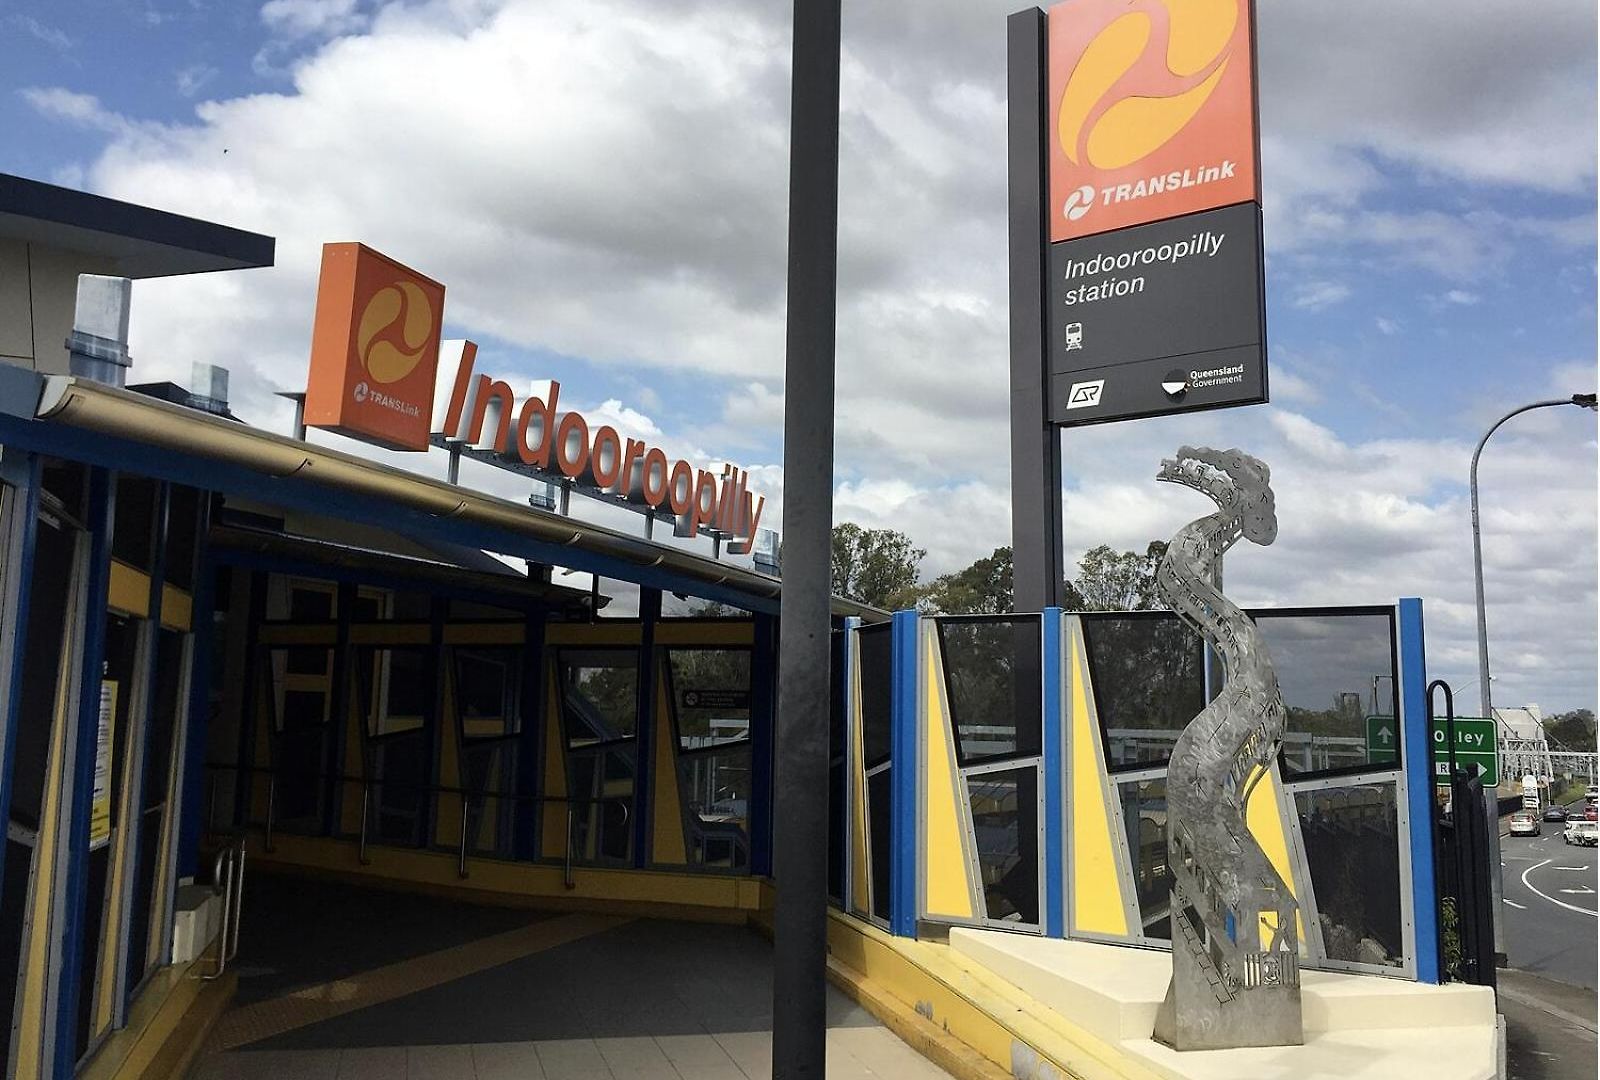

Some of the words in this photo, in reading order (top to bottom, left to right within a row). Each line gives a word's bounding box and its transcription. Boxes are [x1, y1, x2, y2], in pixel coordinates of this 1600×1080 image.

[1101, 160, 1237, 206] TRANSLink
[1064, 231, 1225, 280] Indooroopilly
[1064, 276, 1145, 306] station
[1190, 363, 1244, 380] Queensland
[1192, 374, 1242, 388] Government
[369, 390, 420, 416] TRANSLink
[443, 341, 766, 554] Indooroopilly
[1434, 730, 1484, 746] Oley
